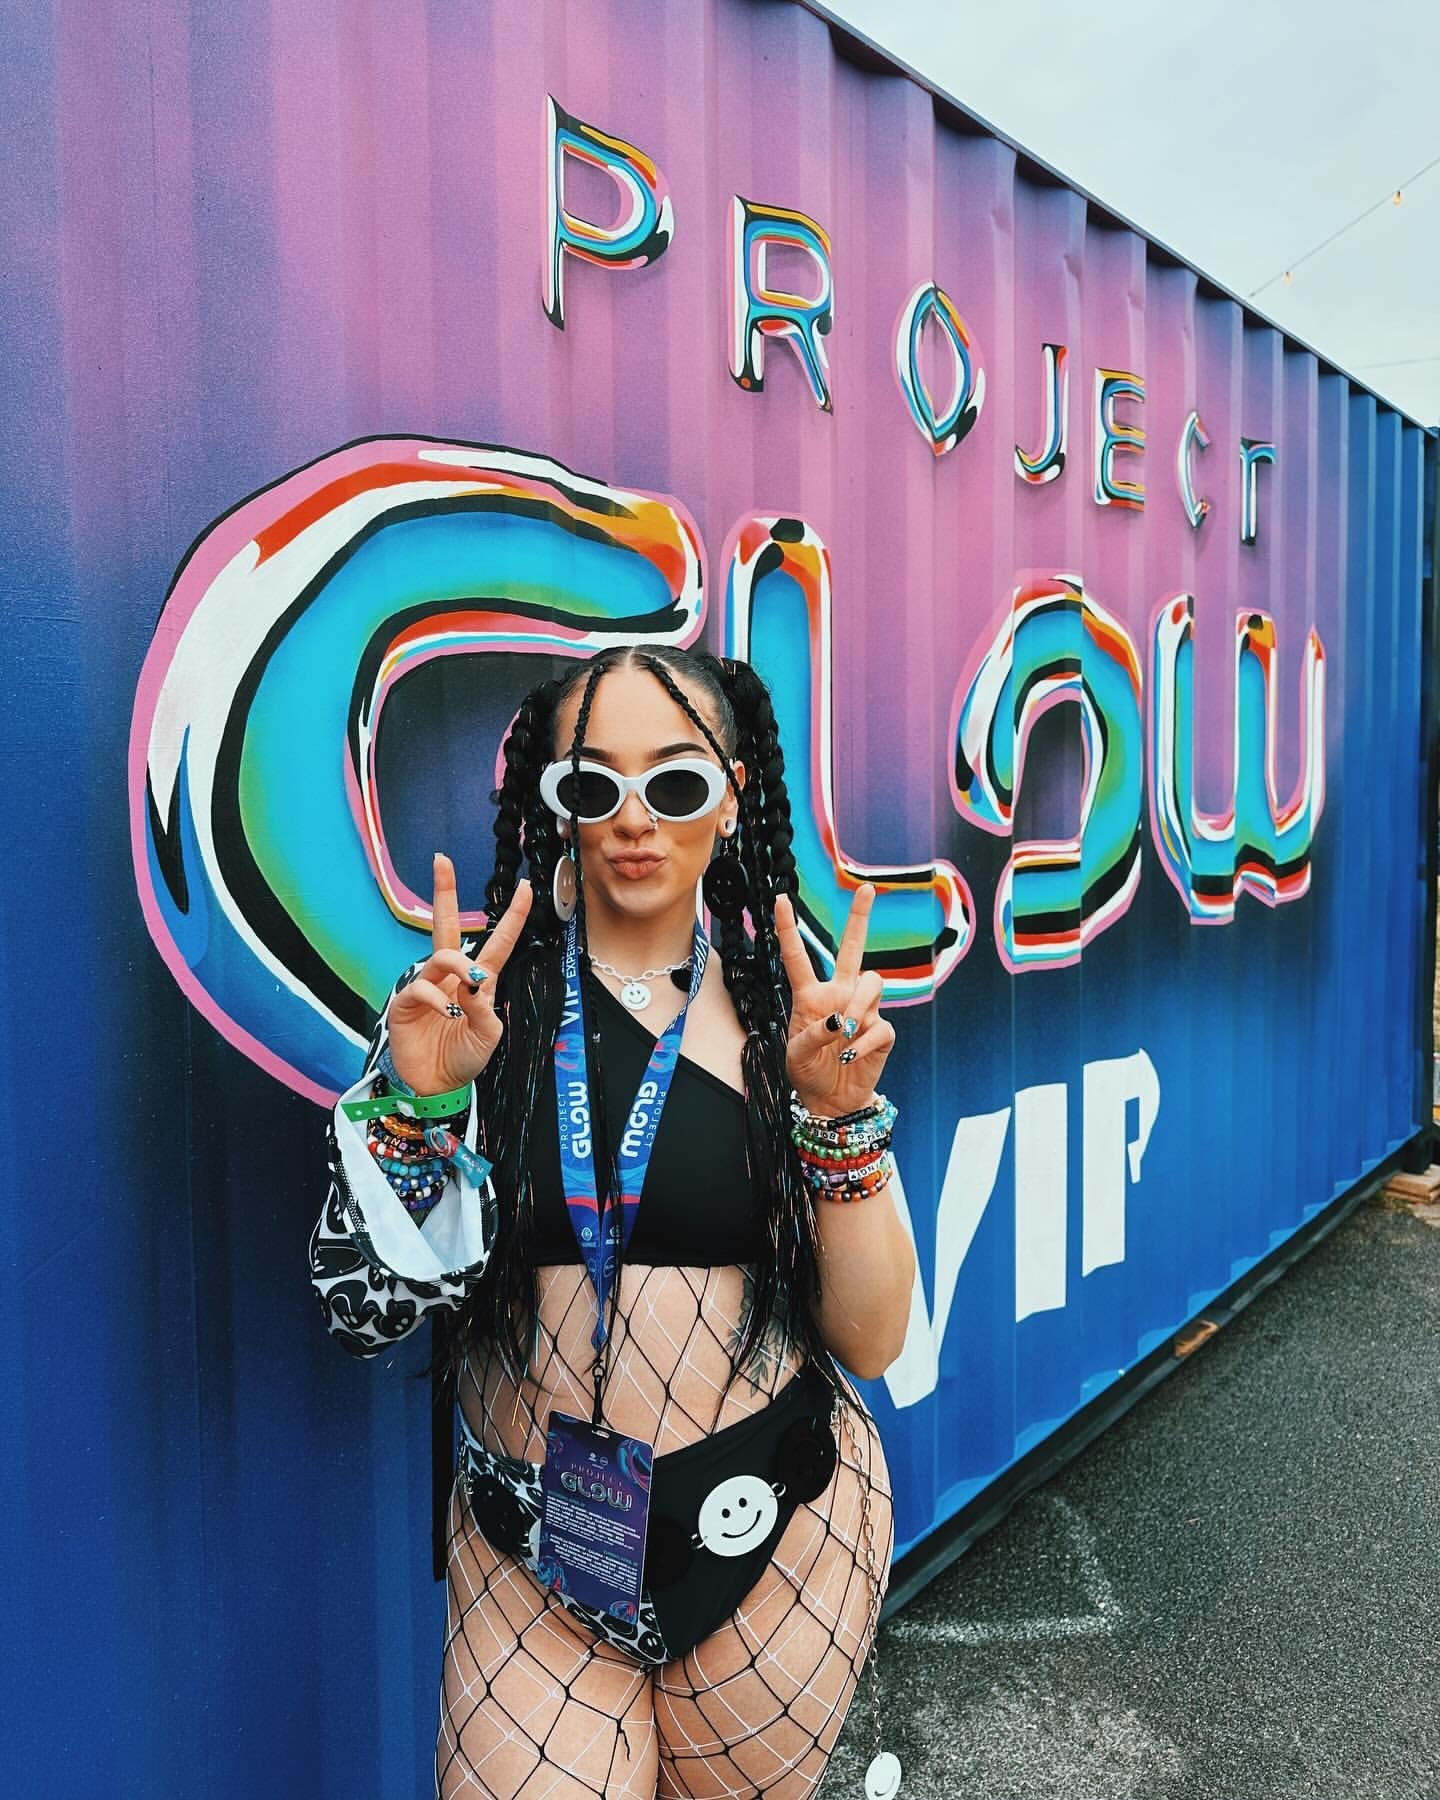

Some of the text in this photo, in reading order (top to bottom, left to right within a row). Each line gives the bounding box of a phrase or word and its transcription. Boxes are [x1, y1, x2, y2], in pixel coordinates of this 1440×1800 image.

[541, 94, 1276, 549] PROJECT
[129, 434, 1325, 1107] GLOW
[558, 1093, 569, 1151] PROJECT
[568, 1081, 592, 1159] GLOW
[620, 1081, 659, 1159] GLOW
[643, 1091, 667, 1147] PROJECT
[882, 1048, 1161, 1410] VIP
[560, 1471, 633, 1512] GLOW
